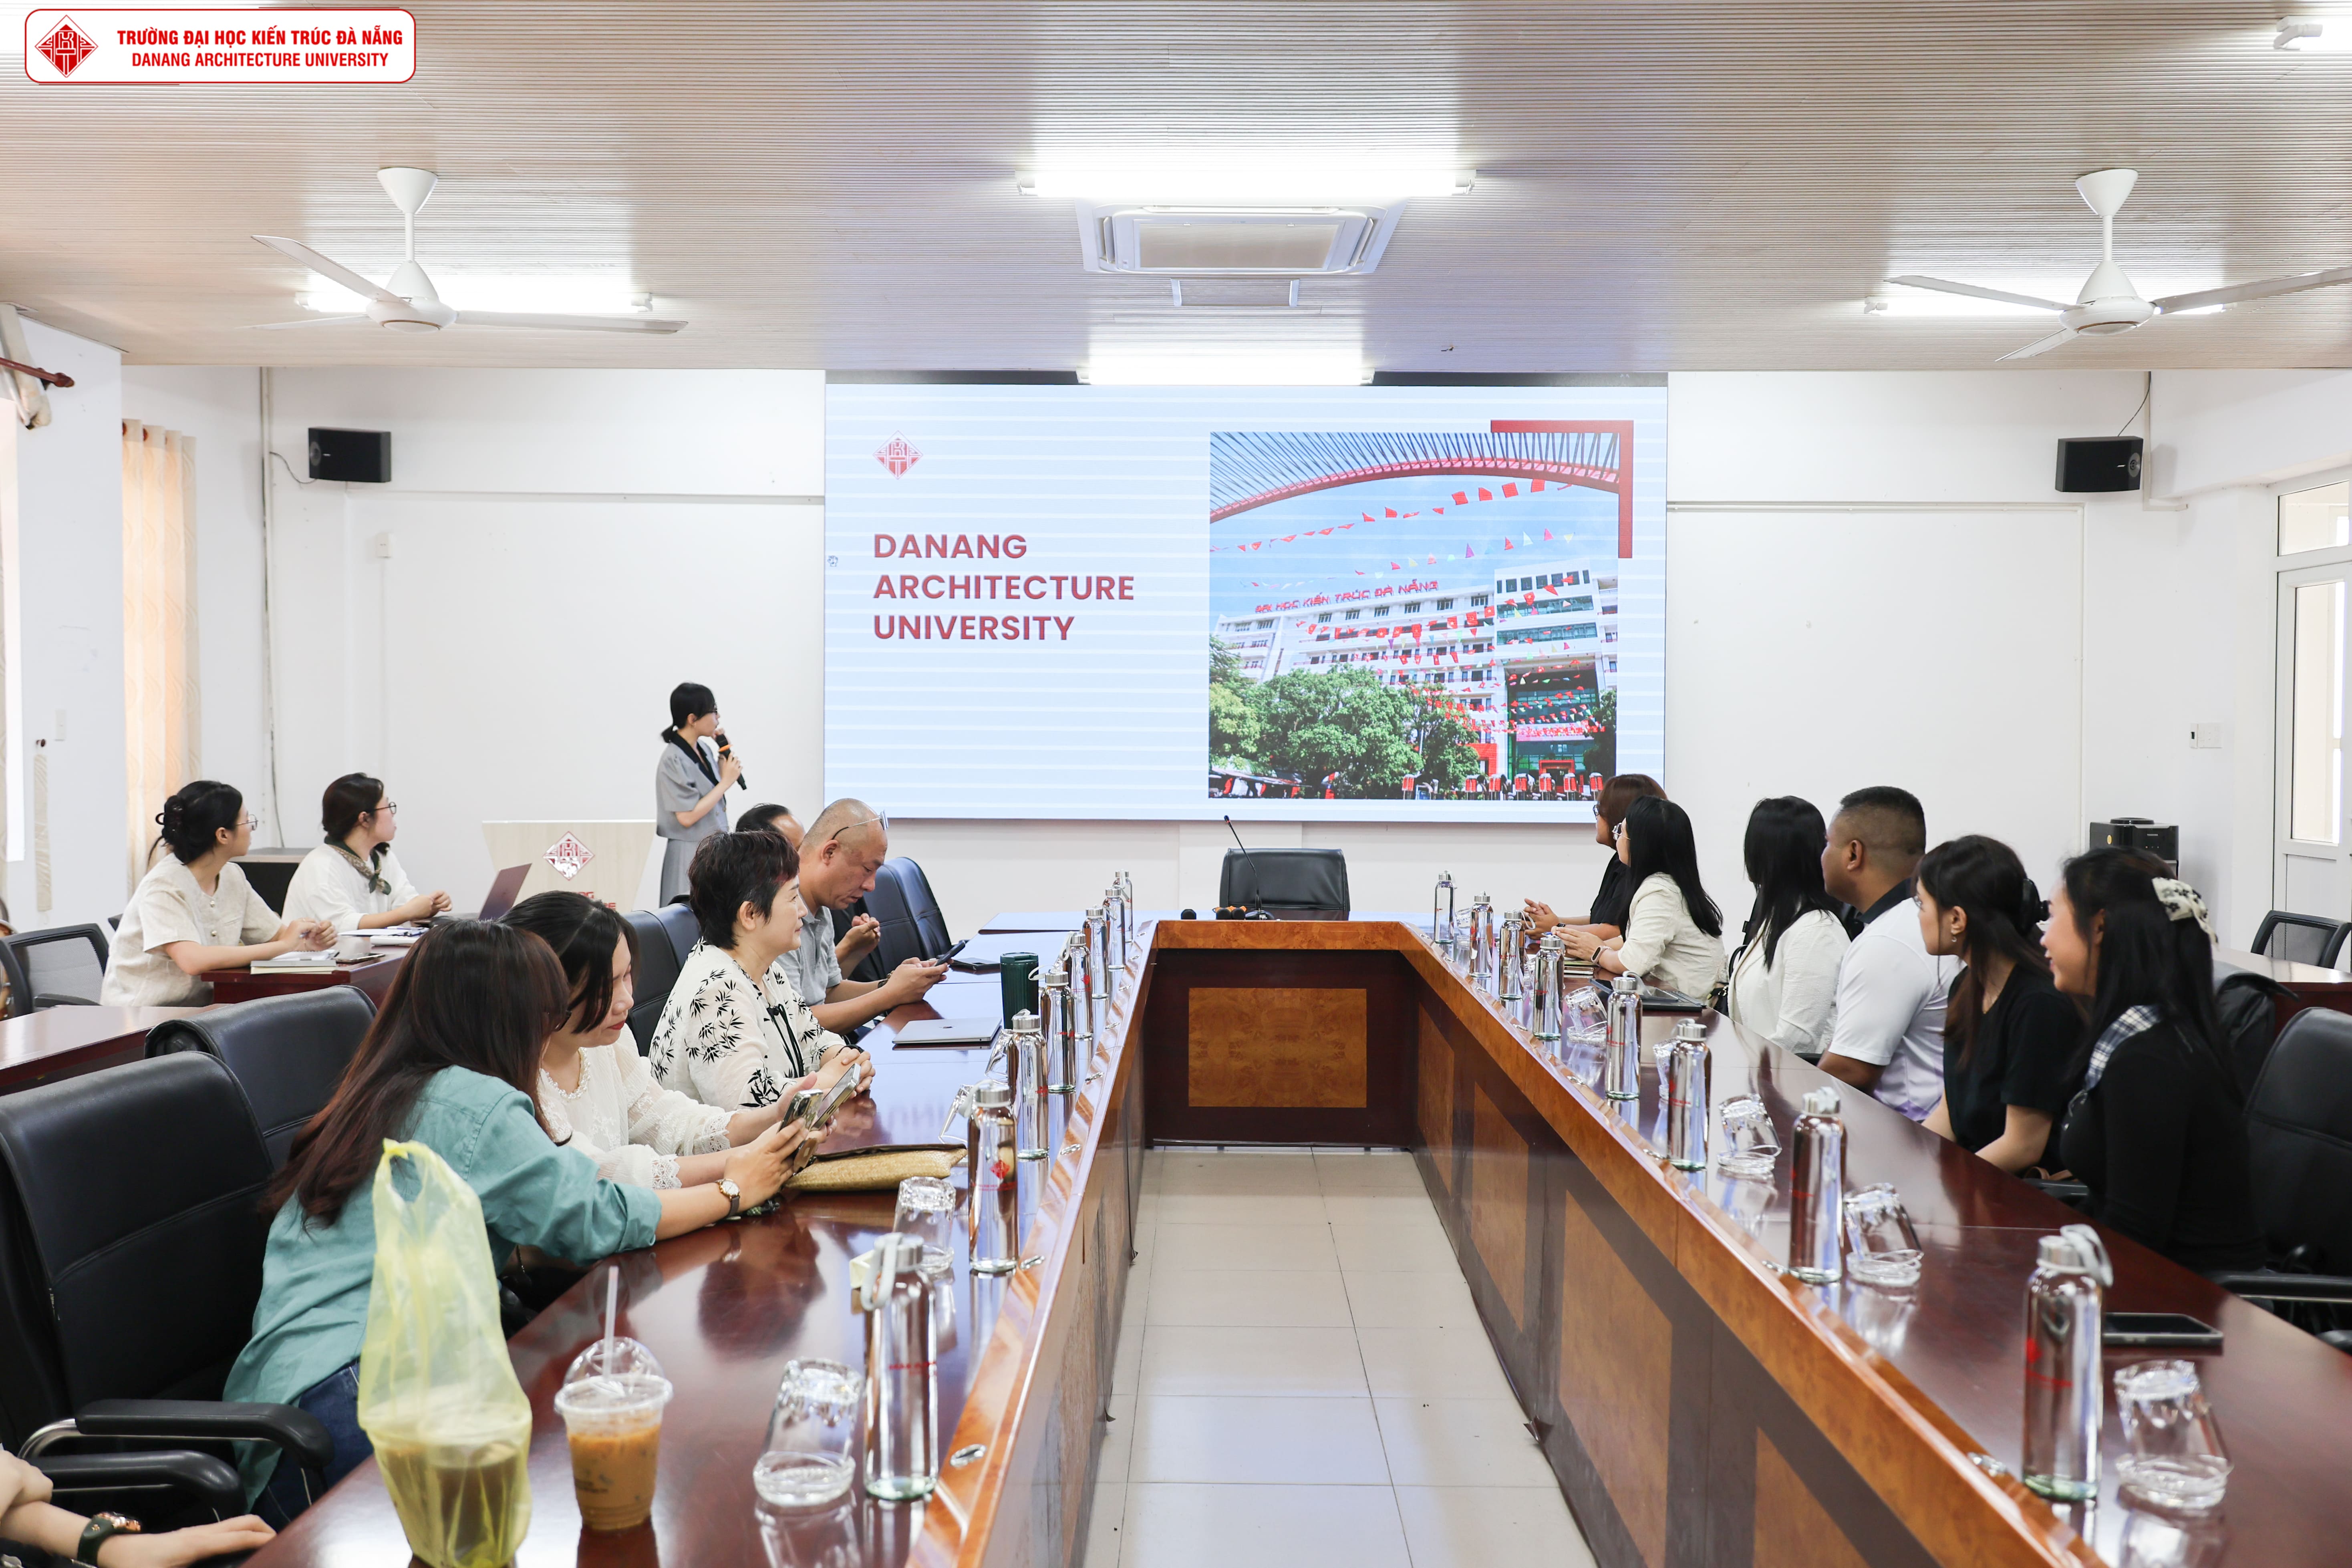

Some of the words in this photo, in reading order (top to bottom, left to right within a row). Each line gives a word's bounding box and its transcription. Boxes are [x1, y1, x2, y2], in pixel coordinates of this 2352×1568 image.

[874, 534, 1027, 559] DANANG
[874, 575, 1134, 600] ARCHITECTURE
[874, 615, 1074, 640] UNIVERSITY
